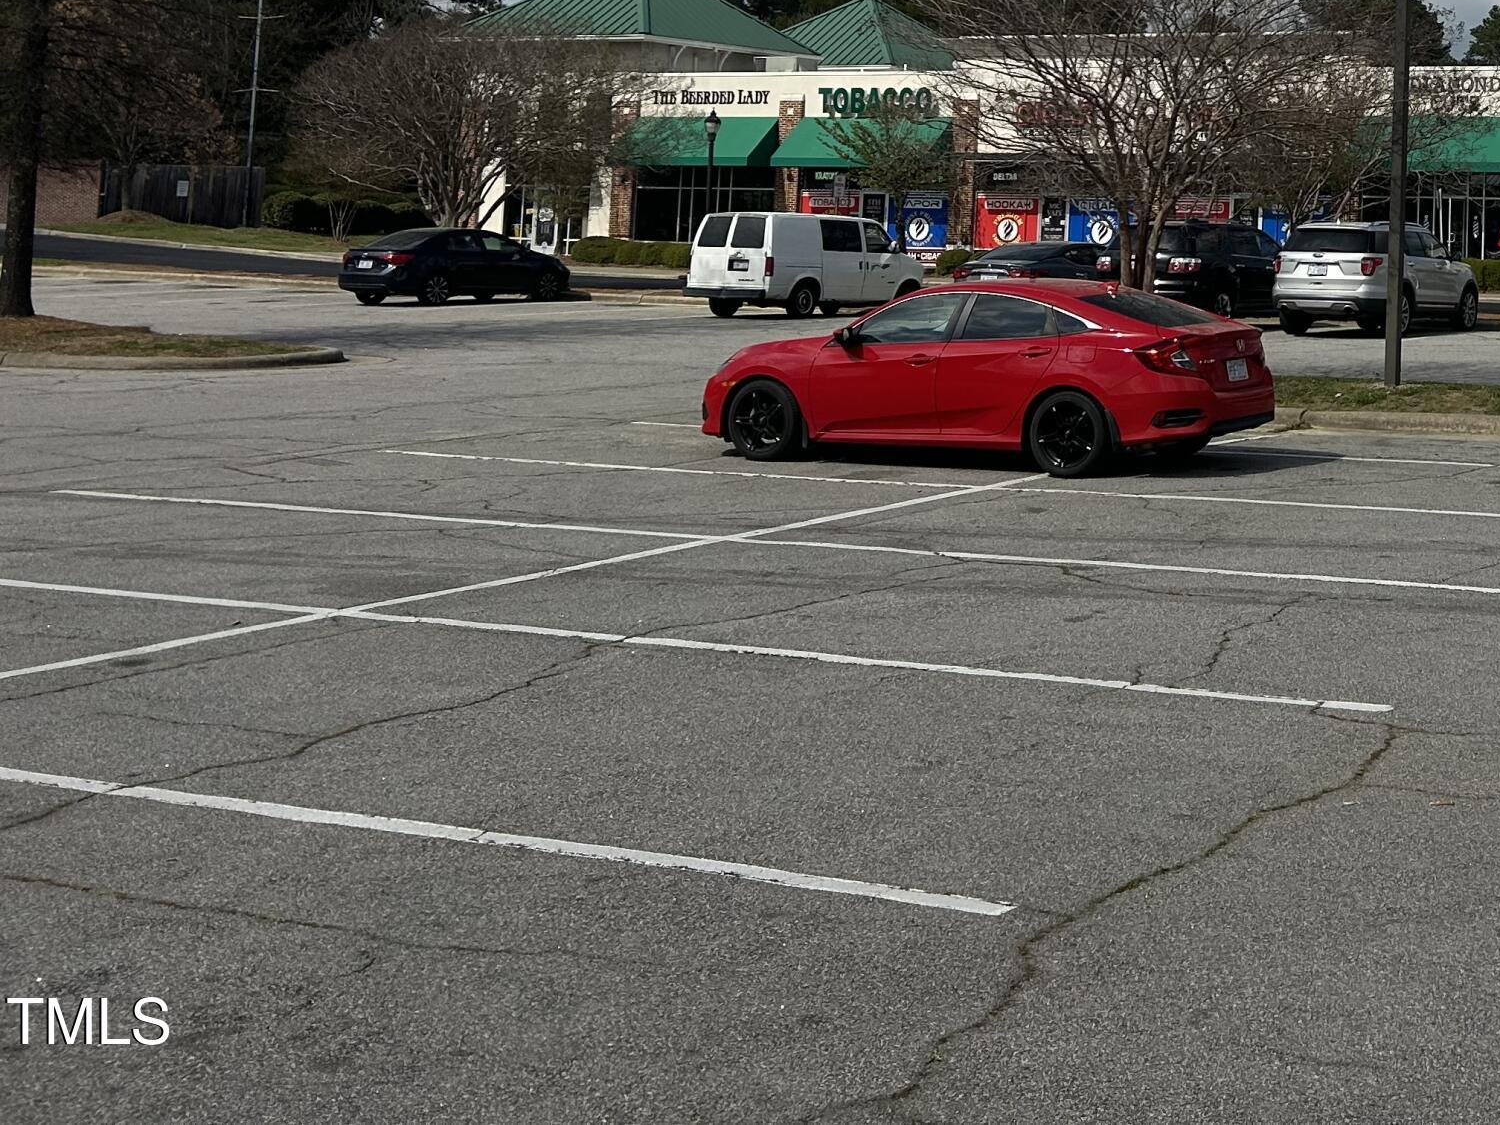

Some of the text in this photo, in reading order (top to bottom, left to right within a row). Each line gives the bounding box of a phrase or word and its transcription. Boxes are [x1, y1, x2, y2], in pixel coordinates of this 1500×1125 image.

[651, 90, 677, 105] THE
[737, 90, 771, 105] LADY
[818, 87, 936, 117] TOBACCO
[812, 198, 852, 207] TOBACO
[904, 199, 941, 209] APOR
[986, 200, 1031, 209] HOOKAH
